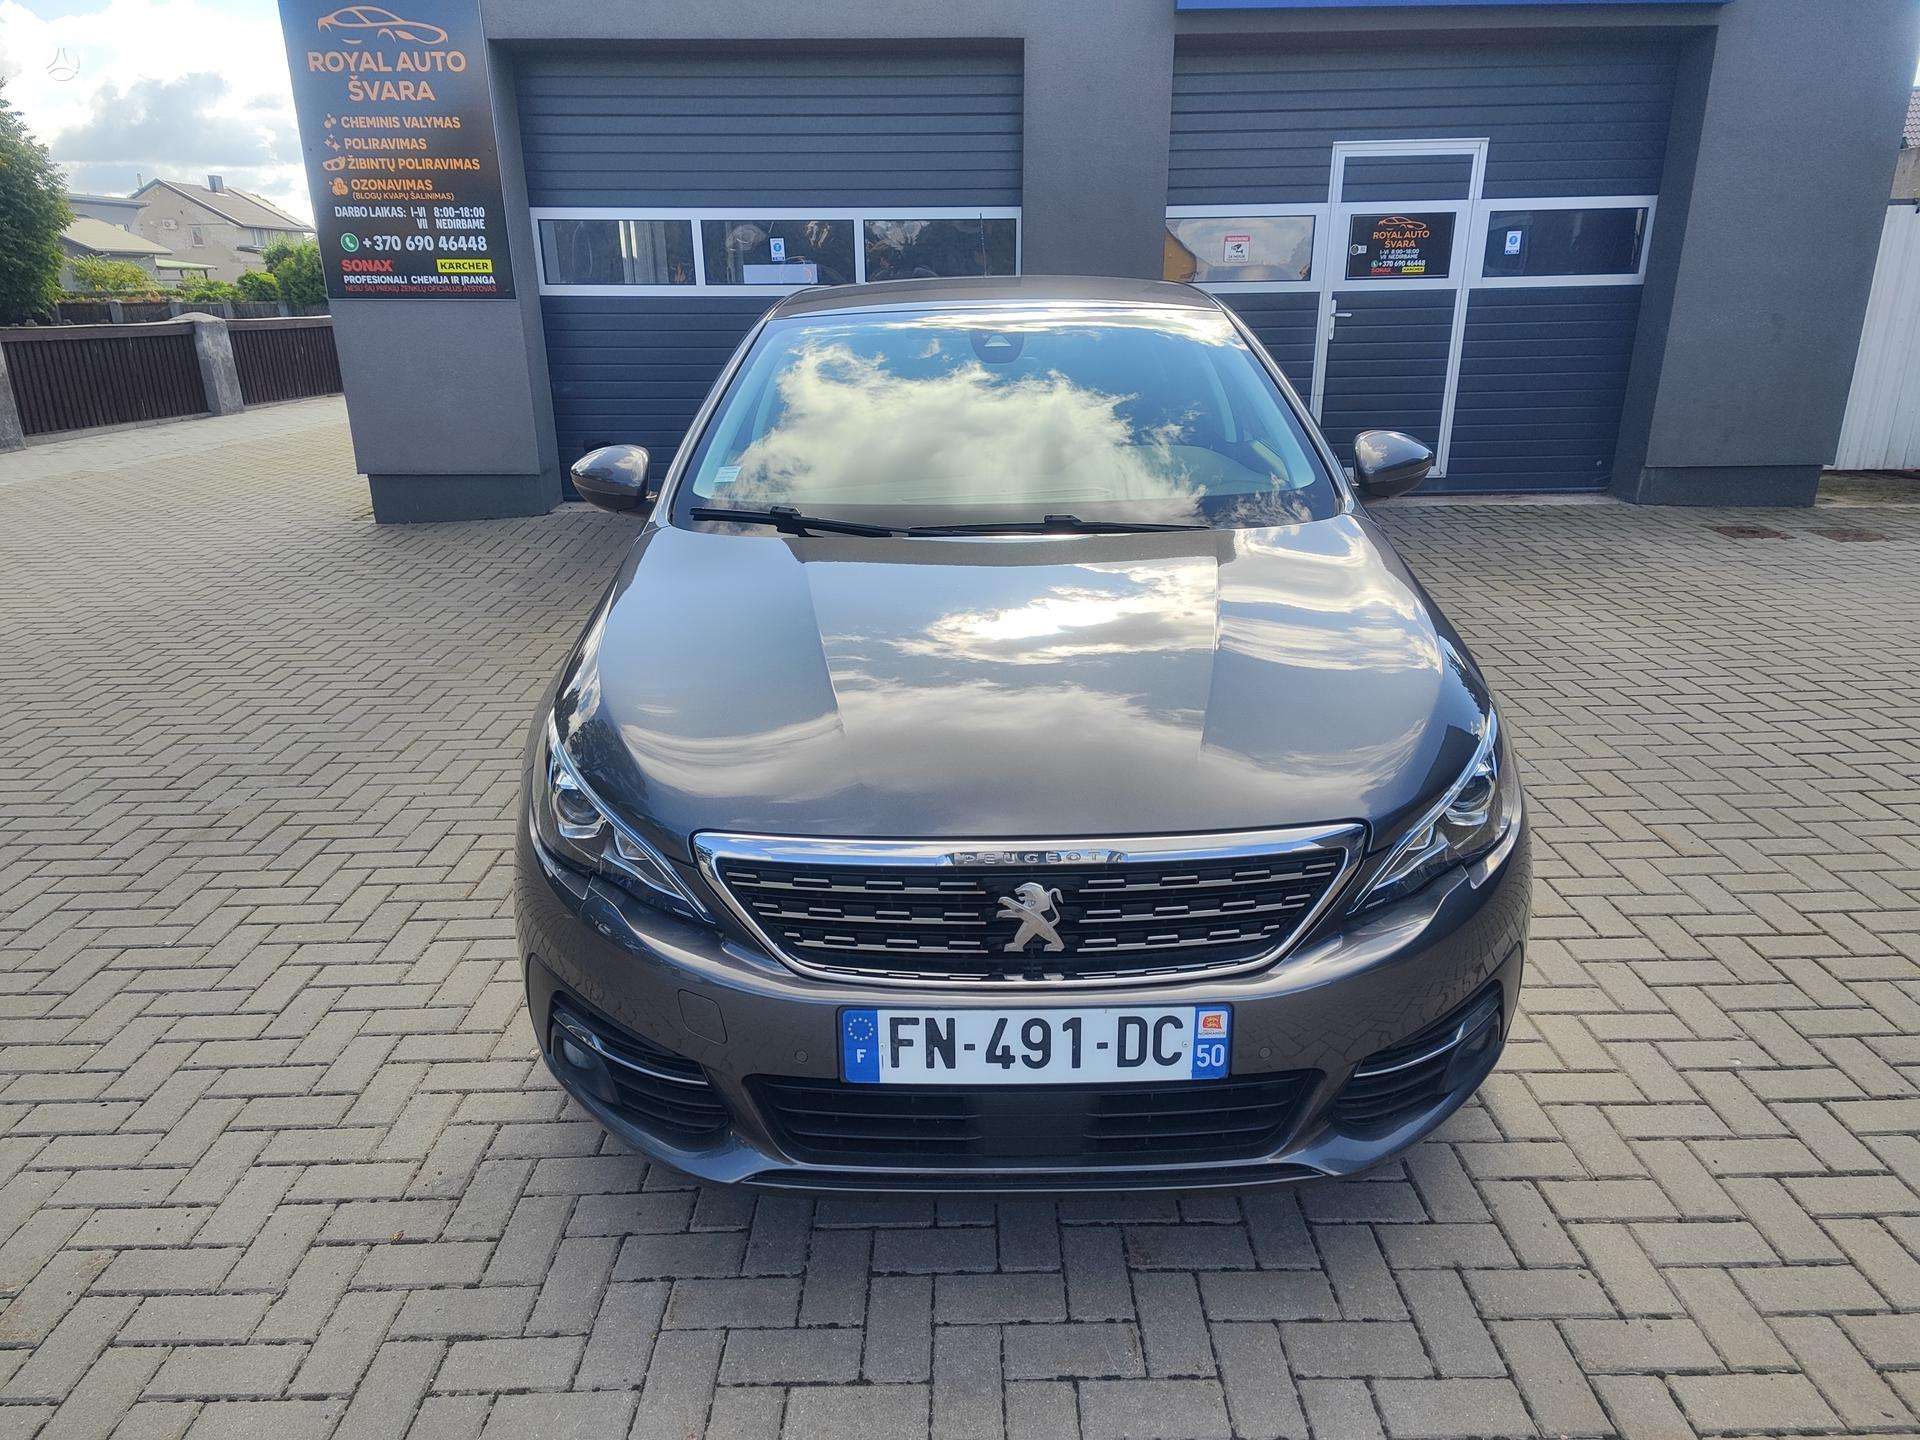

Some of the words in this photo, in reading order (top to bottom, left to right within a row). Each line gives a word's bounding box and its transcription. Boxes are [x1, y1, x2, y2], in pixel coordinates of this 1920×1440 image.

[307, 51, 393, 72] ROYAL
[396, 51, 466, 72] AUTO
[348, 75, 436, 101] ŠVARA
[340, 116, 400, 129] CHEMINIS
[402, 116, 461, 129] VALYMAS
[344, 137, 428, 150] POLIRAVIMAS
[348, 155, 396, 172] ŽIBINTŲ
[400, 158, 480, 171] POLIRAVIMAS
[351, 178, 433, 191] OZONAVIMAS
[335, 206, 367, 218] DARBO
[369, 206, 407, 218] LAIKAS:
[411, 206, 426, 217] I-VI
[417, 219, 428, 229] VII
[436, 219, 485, 230] NEDIRBAME
[1373, 231, 1402, 240] ROYAL
[1403, 230, 1430, 238] AUTO
[363, 235, 401, 251] +370
[405, 235, 434, 251] 690
[438, 235, 487, 251] 46448
[341, 260, 393, 272] SONAX
[343, 275, 407, 285] PROFESIONALI
[411, 275, 449, 285] CHEMIJA
[451, 275, 460, 284] IR
[961, 850, 1102, 864] PEUGEOT
[856, 1049, 866, 1063] F
[889, 1015, 1184, 1069] FN-491-DC
[1197, 1044, 1225, 1067] 50
